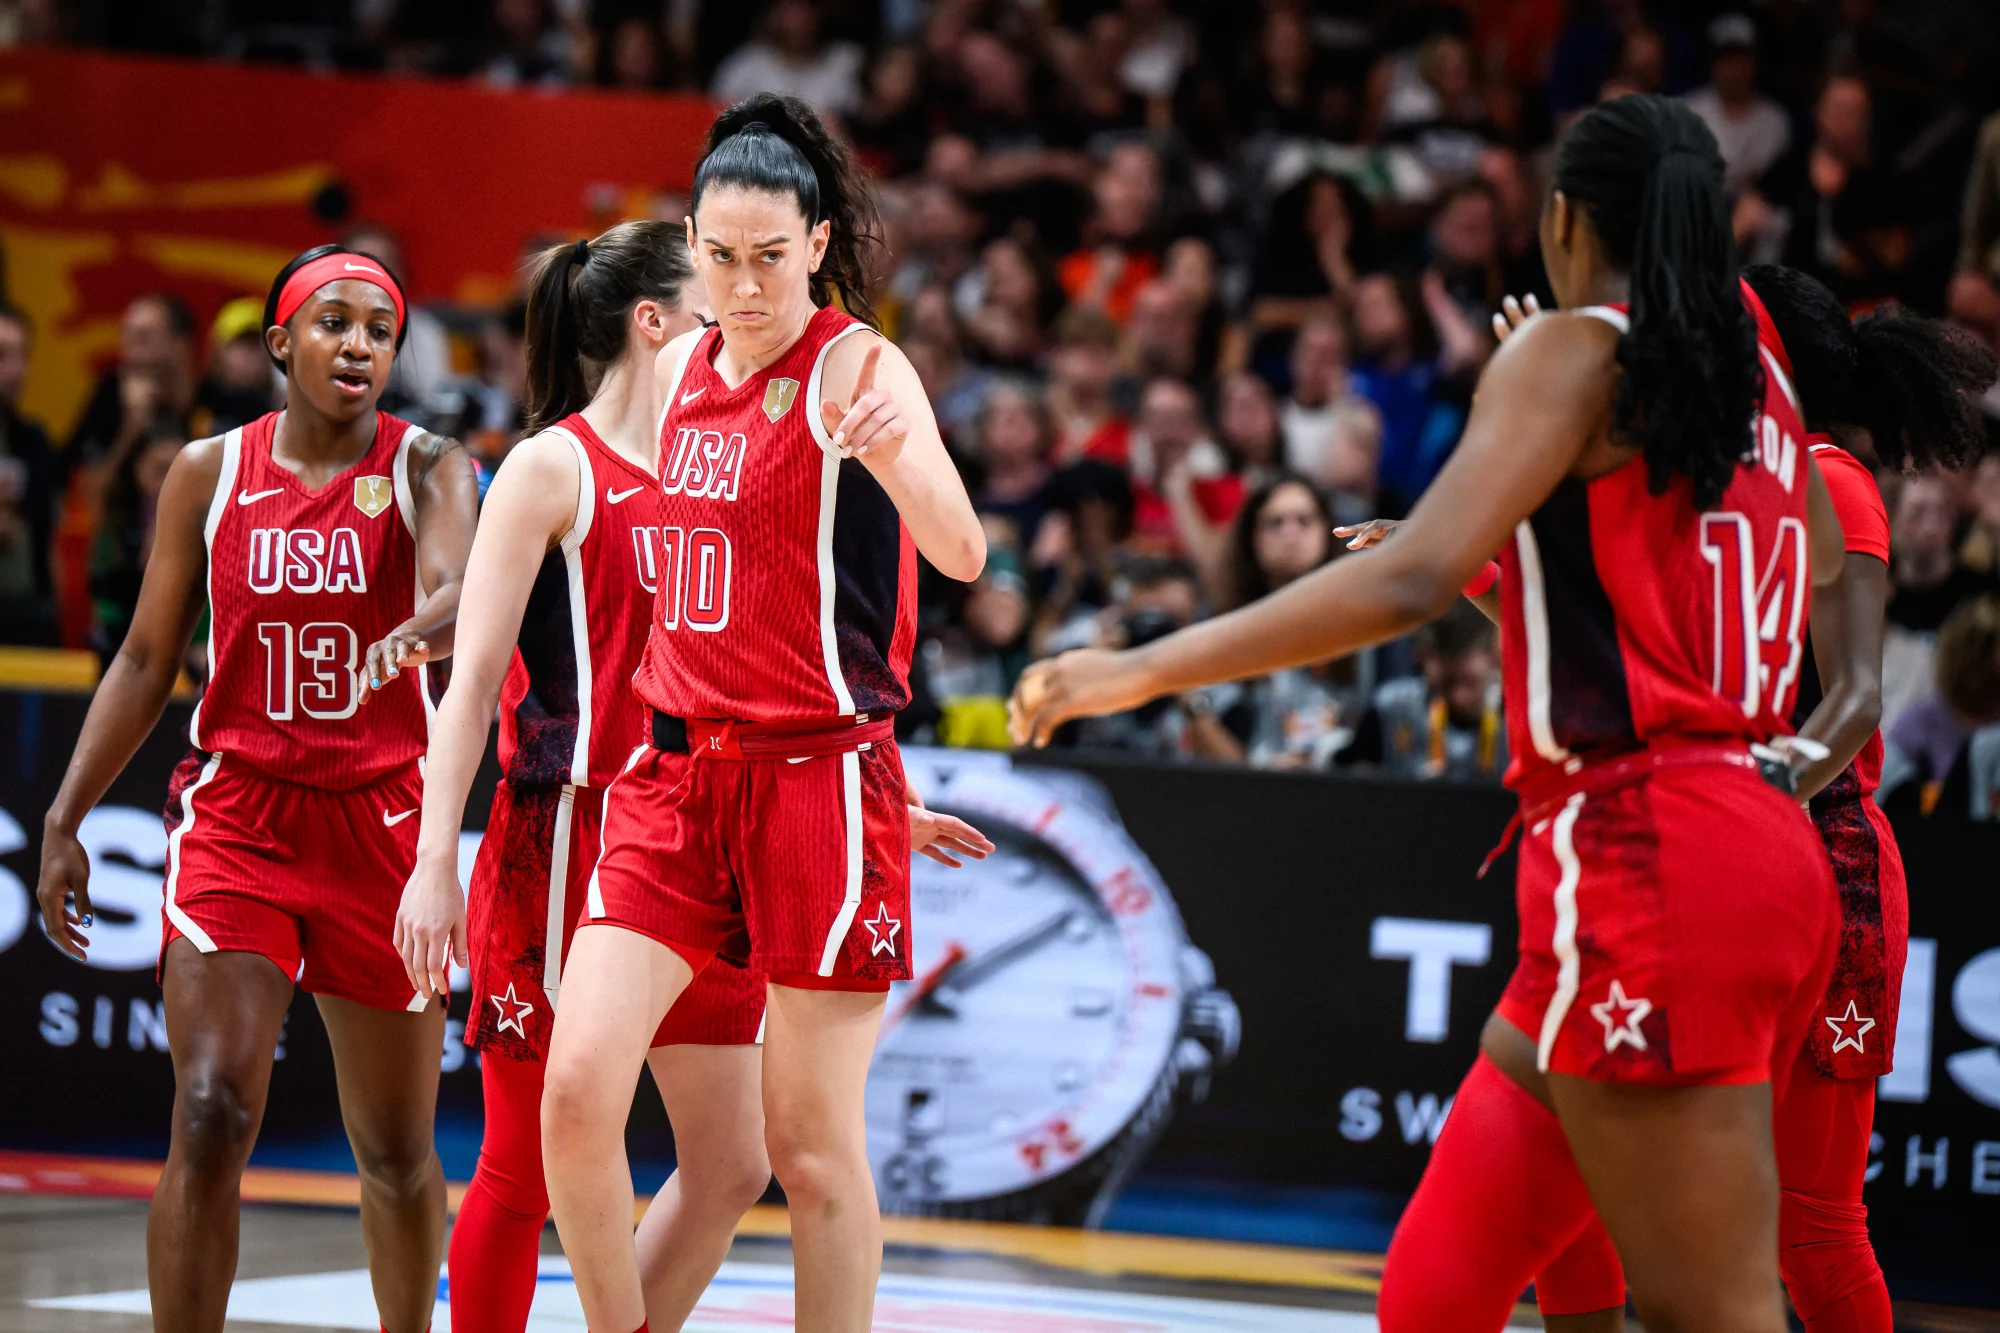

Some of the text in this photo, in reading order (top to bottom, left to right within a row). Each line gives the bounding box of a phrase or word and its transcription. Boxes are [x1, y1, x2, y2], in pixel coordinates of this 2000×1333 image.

[663, 428, 746, 501] USA
[248, 527, 367, 594] USA
[663, 527, 732, 632] 10
[1700, 511, 1806, 719] 14
[257, 621, 358, 721] 13
